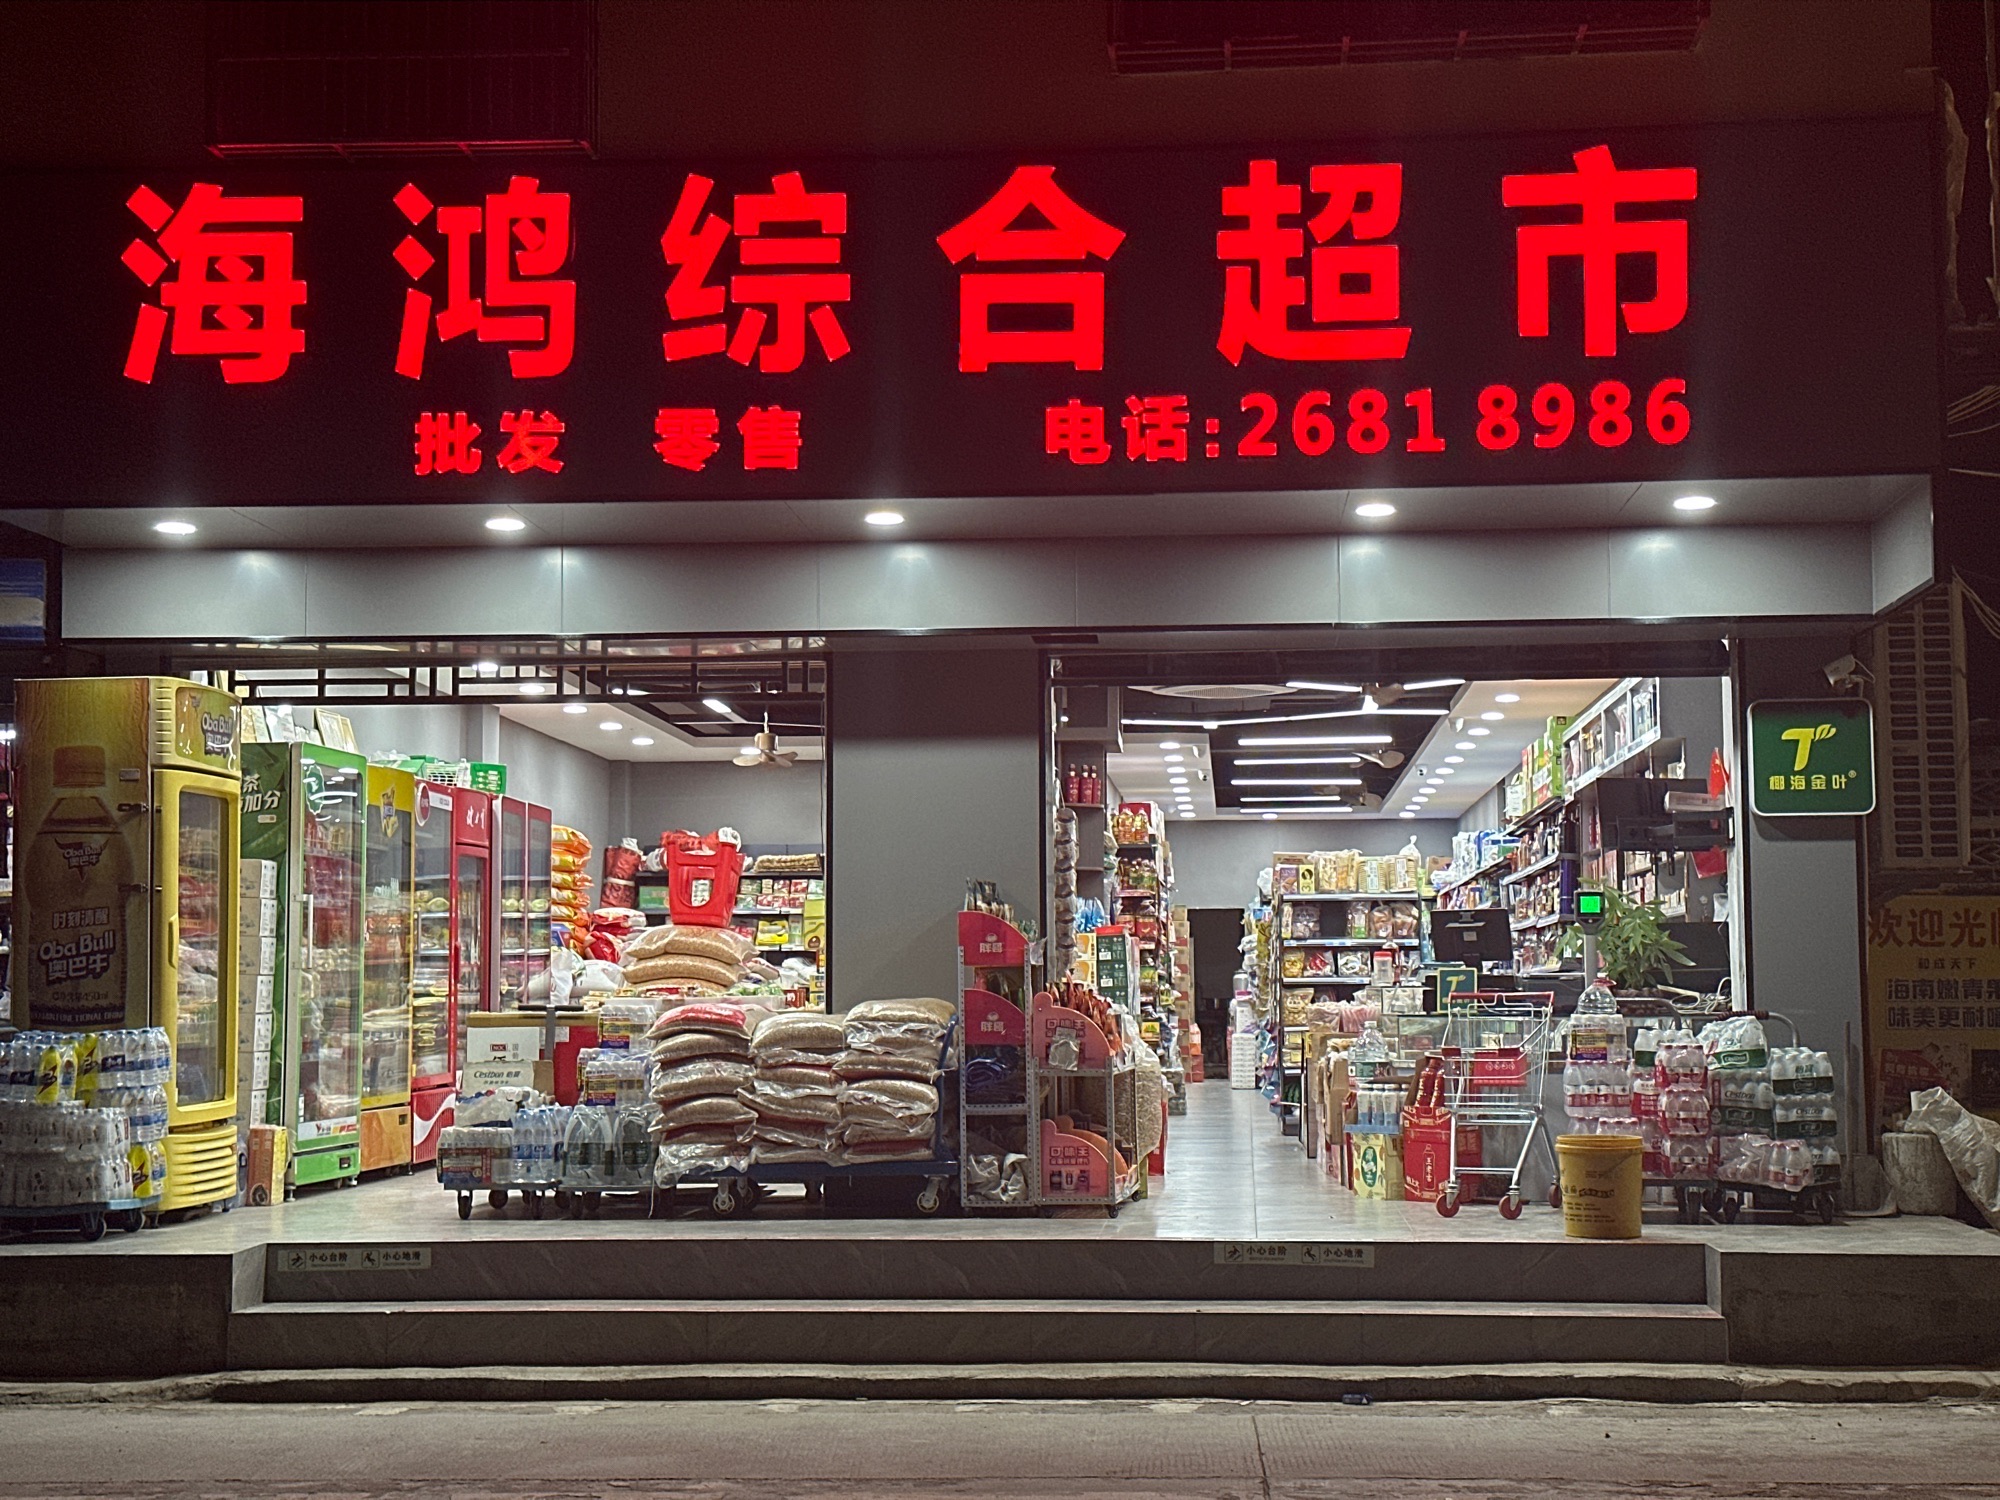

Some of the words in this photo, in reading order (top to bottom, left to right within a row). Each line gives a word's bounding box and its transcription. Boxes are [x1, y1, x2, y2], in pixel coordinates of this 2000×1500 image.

[121, 144, 1698, 385] 海鸿综合超市
[414, 410, 565, 475] 批发
[652, 405, 803, 471] 零售
[202, 712, 218, 731] Oba
[243, 773, 260, 792] 茶
[1769, 774, 1847, 790] 椰海金叶
[241, 790, 281, 813] 加分
[53, 907, 110, 929] 时刻清醒
[1868, 908, 2000, 949] 欢迎光
[39, 938, 77, 960] Oba
[79, 930, 115, 955] Bull
[48, 954, 109, 980] 奥巴牛
[1918, 957, 1977, 970] 和成天下
[1050, 1146, 1089, 1157] 口味王
[309, 1252, 348, 1262] 小心台阶
[382, 1251, 421, 1261] 小心地滑
[1246, 1245, 1287, 1256] 小心台阶
[1323, 1247, 1364, 1258] 小心地滑
